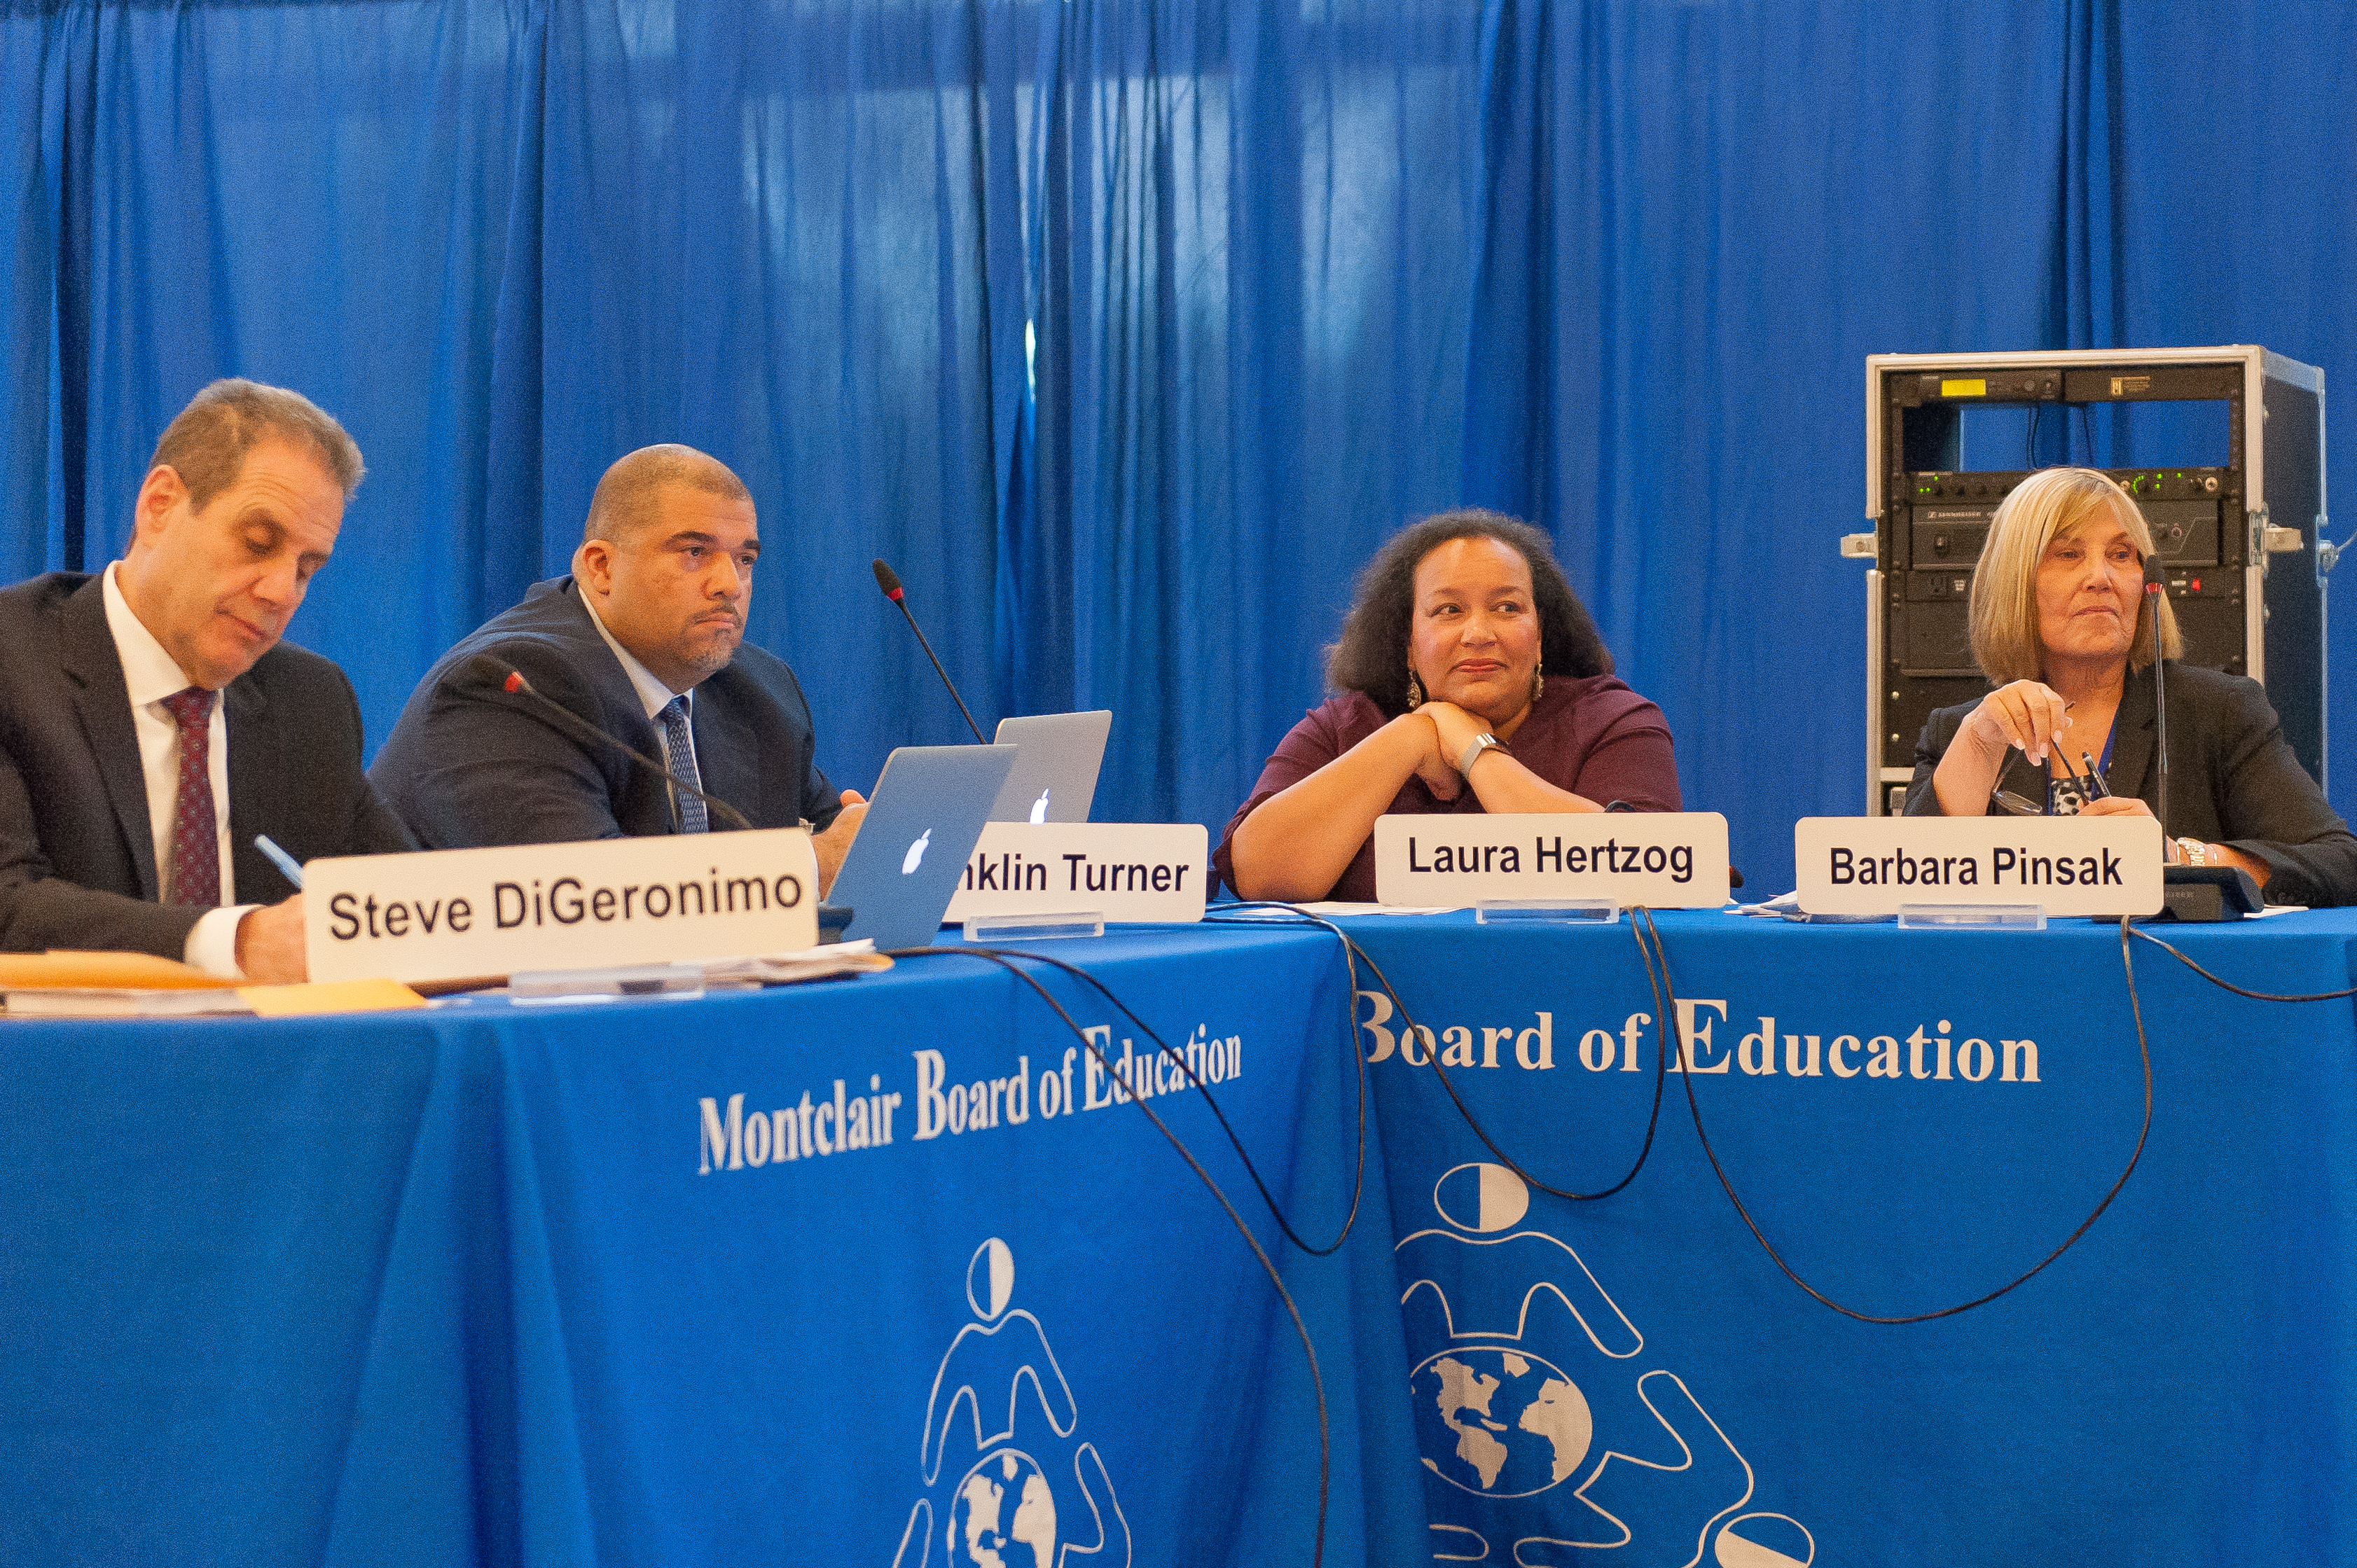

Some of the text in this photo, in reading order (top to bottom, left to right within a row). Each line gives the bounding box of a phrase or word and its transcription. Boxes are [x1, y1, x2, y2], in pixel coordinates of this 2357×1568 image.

[1062, 853, 1189, 891] Turner
[1409, 837, 1693, 883] Laura Hertzog
[1831, 847, 2123, 885] Barbara Pinsak
[329, 866, 801, 941] Steve DiGeronimo
[1356, 990, 2042, 1083] Board of Education
[698, 1023, 1243, 1176] Montclair Board of Education
